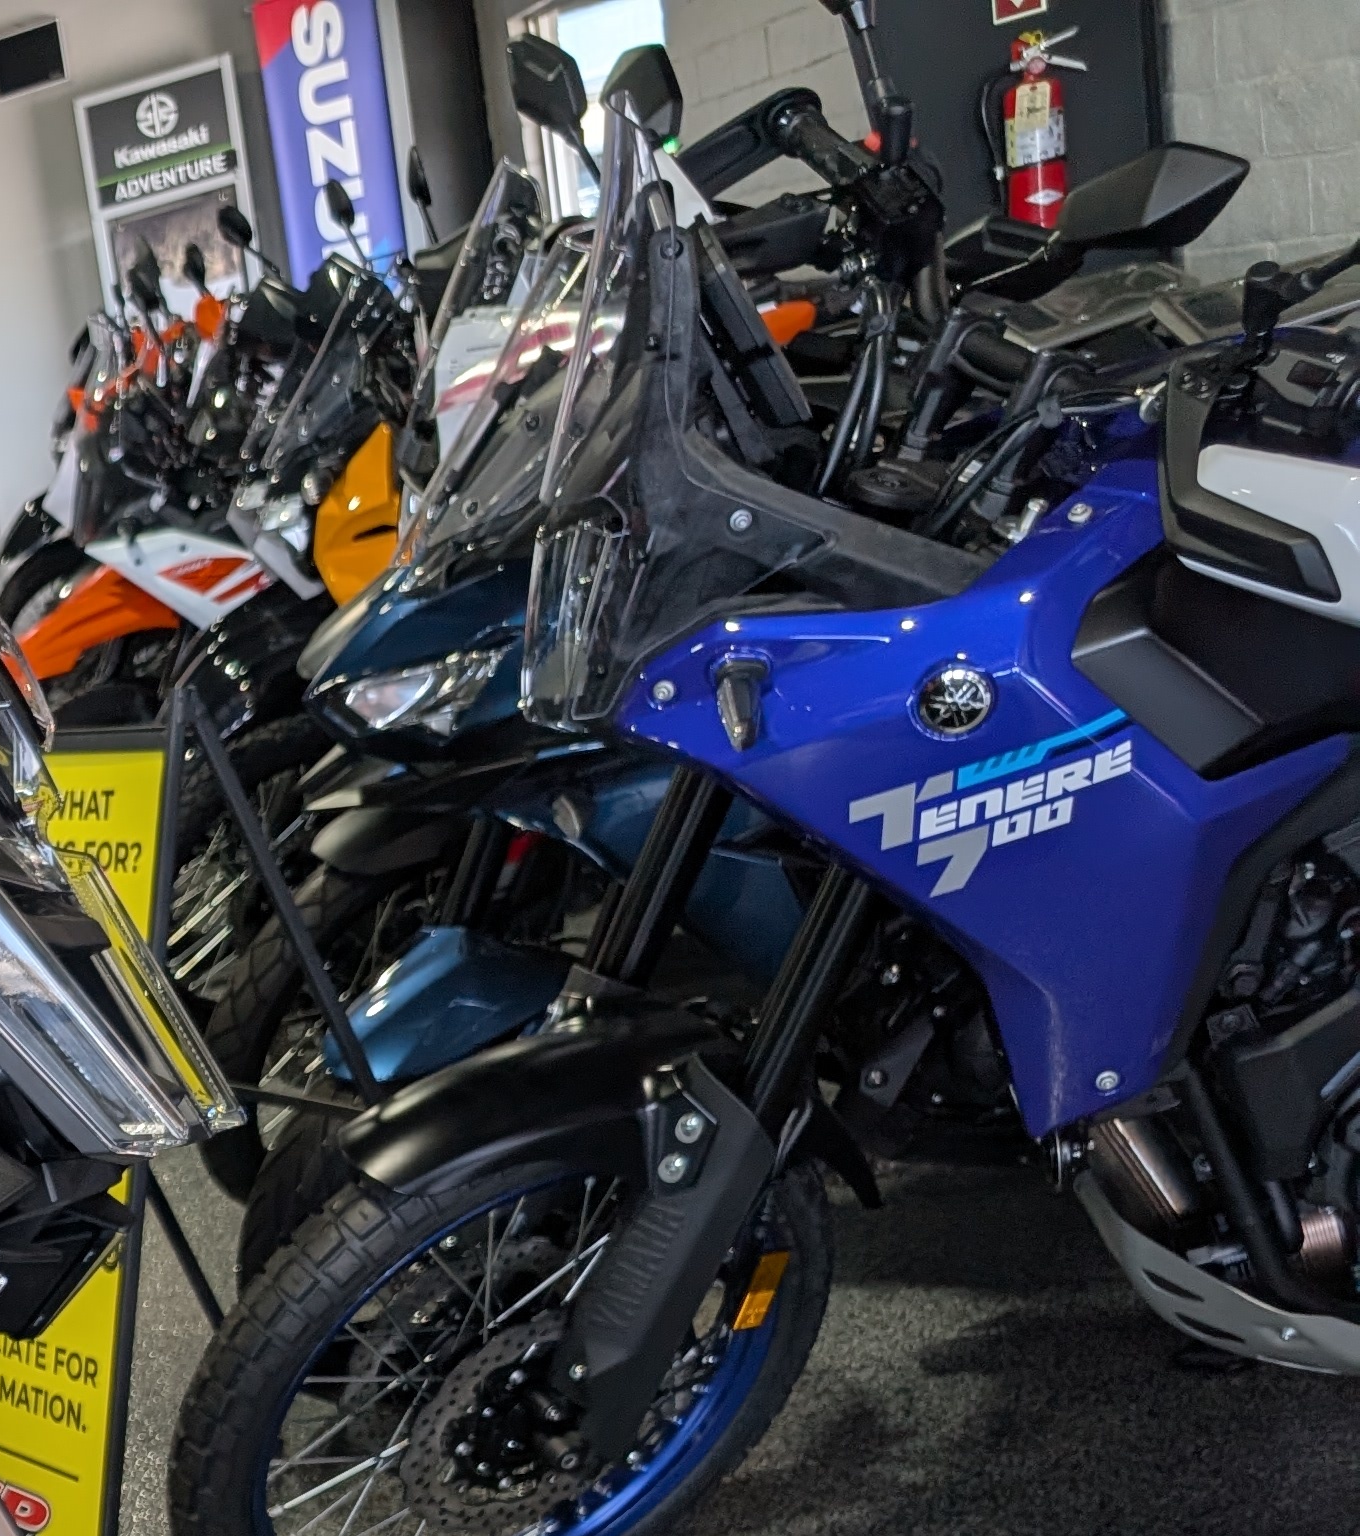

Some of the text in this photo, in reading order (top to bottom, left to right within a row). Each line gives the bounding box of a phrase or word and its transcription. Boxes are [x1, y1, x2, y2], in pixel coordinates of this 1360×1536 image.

[114, 122, 210, 169] Kawasaki
[114, 151, 228, 202] ADVENTURE
[916, 797, 1075, 898] 700
[53, 1347, 99, 1388] FOR
